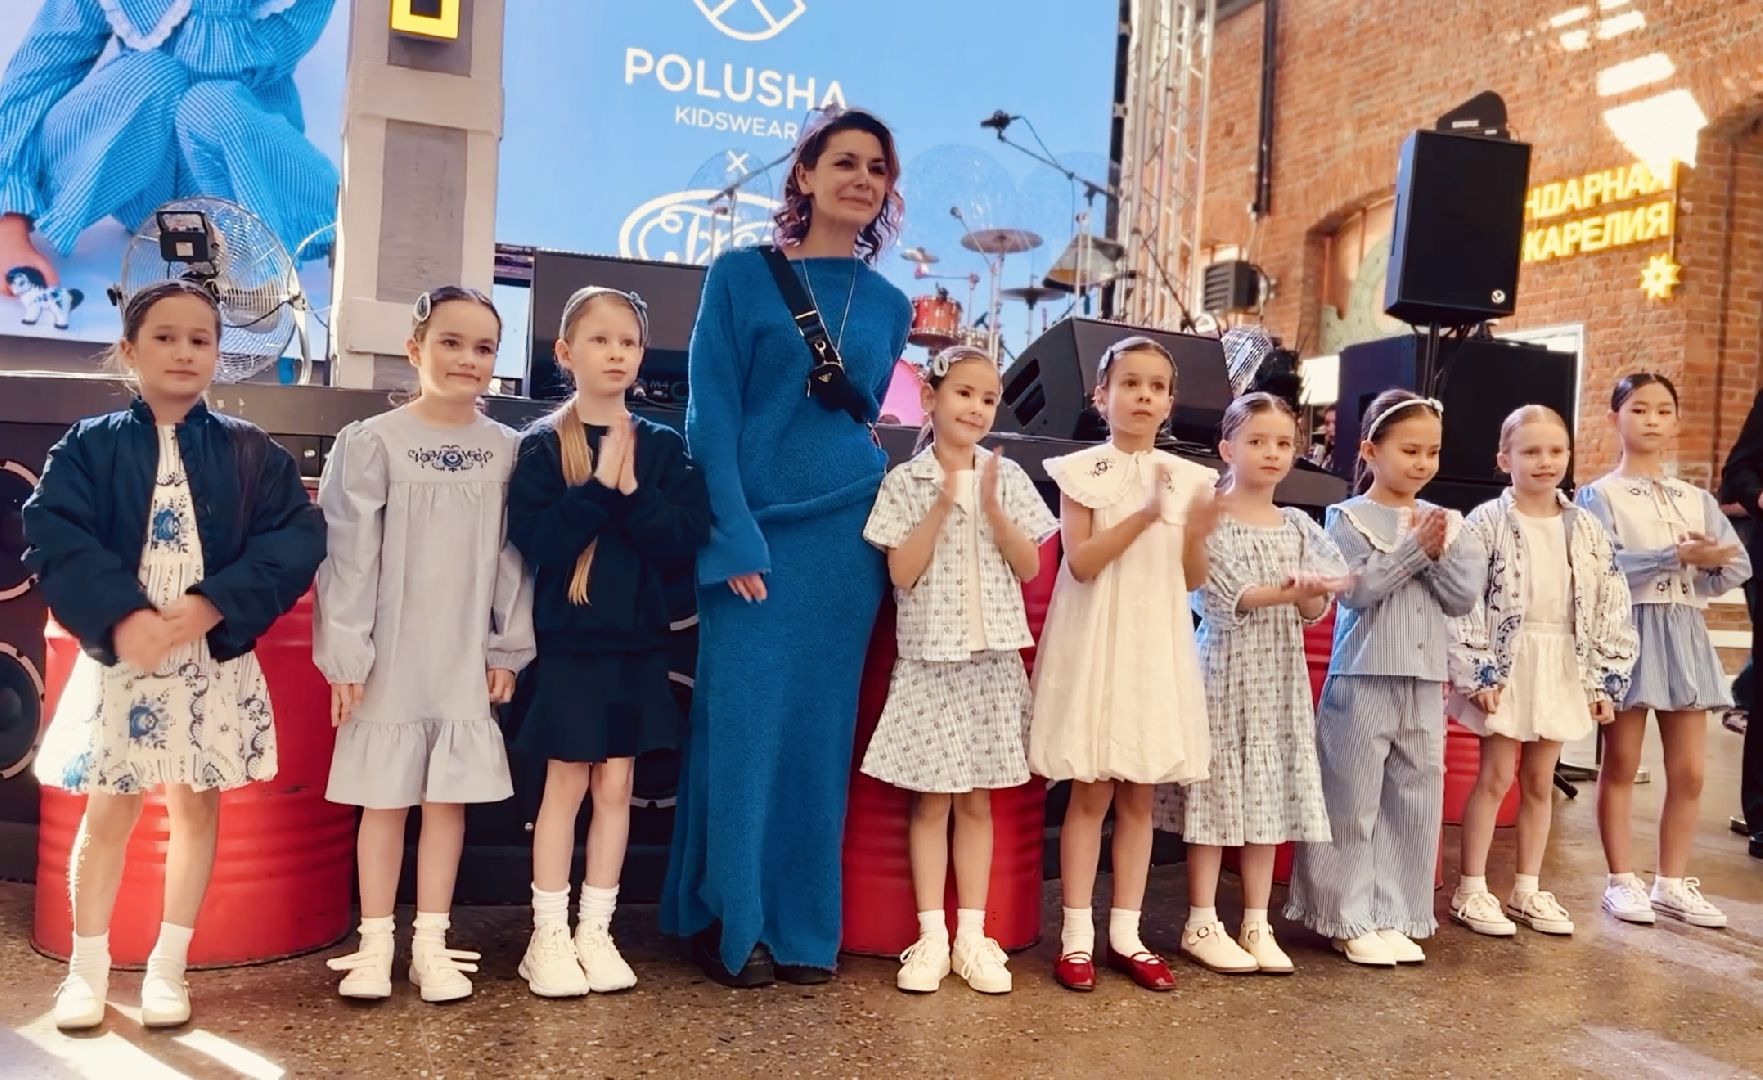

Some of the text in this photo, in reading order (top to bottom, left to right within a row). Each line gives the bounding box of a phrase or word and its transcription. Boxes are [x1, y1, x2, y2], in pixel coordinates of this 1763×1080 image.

[625, 48, 847, 109] POLUSHA
[675, 106, 798, 140] KIDSWEAR
[1524, 202, 1670, 261] КАРЕЛИЯ
